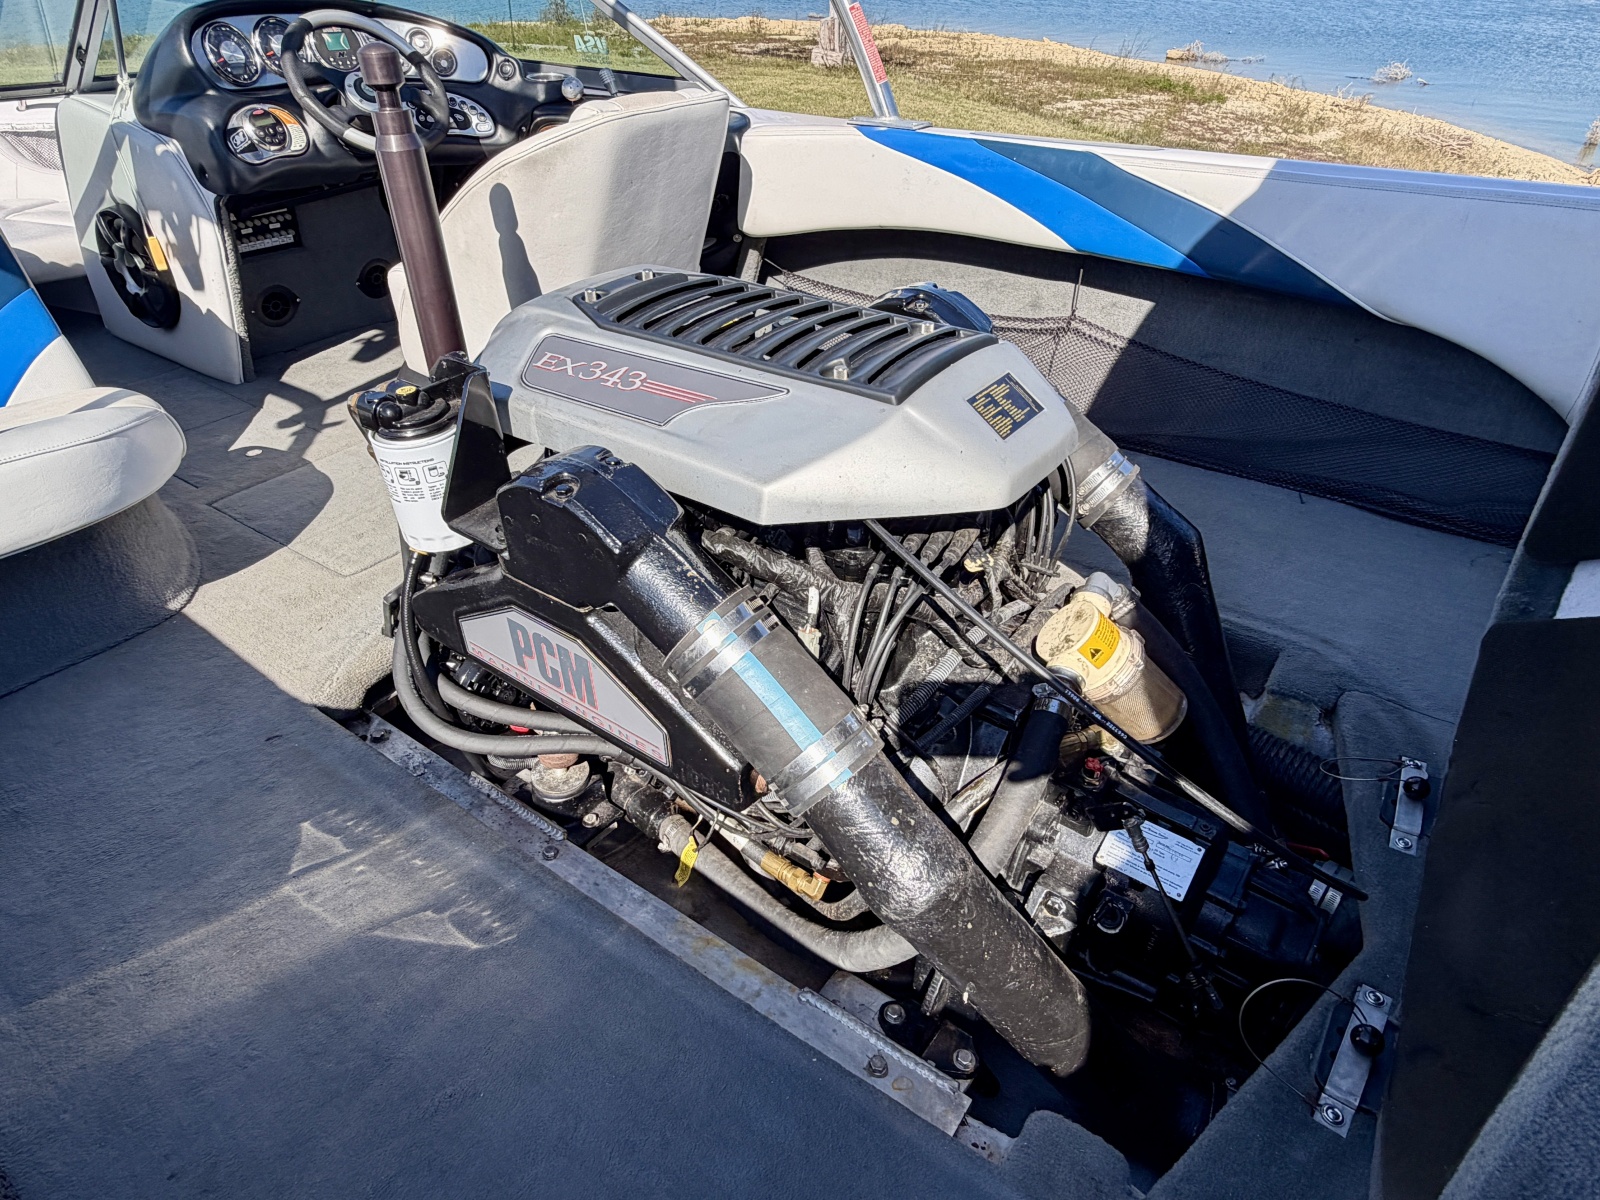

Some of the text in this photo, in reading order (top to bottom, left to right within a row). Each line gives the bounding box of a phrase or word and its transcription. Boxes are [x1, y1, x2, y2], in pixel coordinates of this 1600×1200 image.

[532, 351, 647, 391] EX343
[470, 646, 665, 760] MARINE ENGINES
[507, 617, 599, 711] PCM
